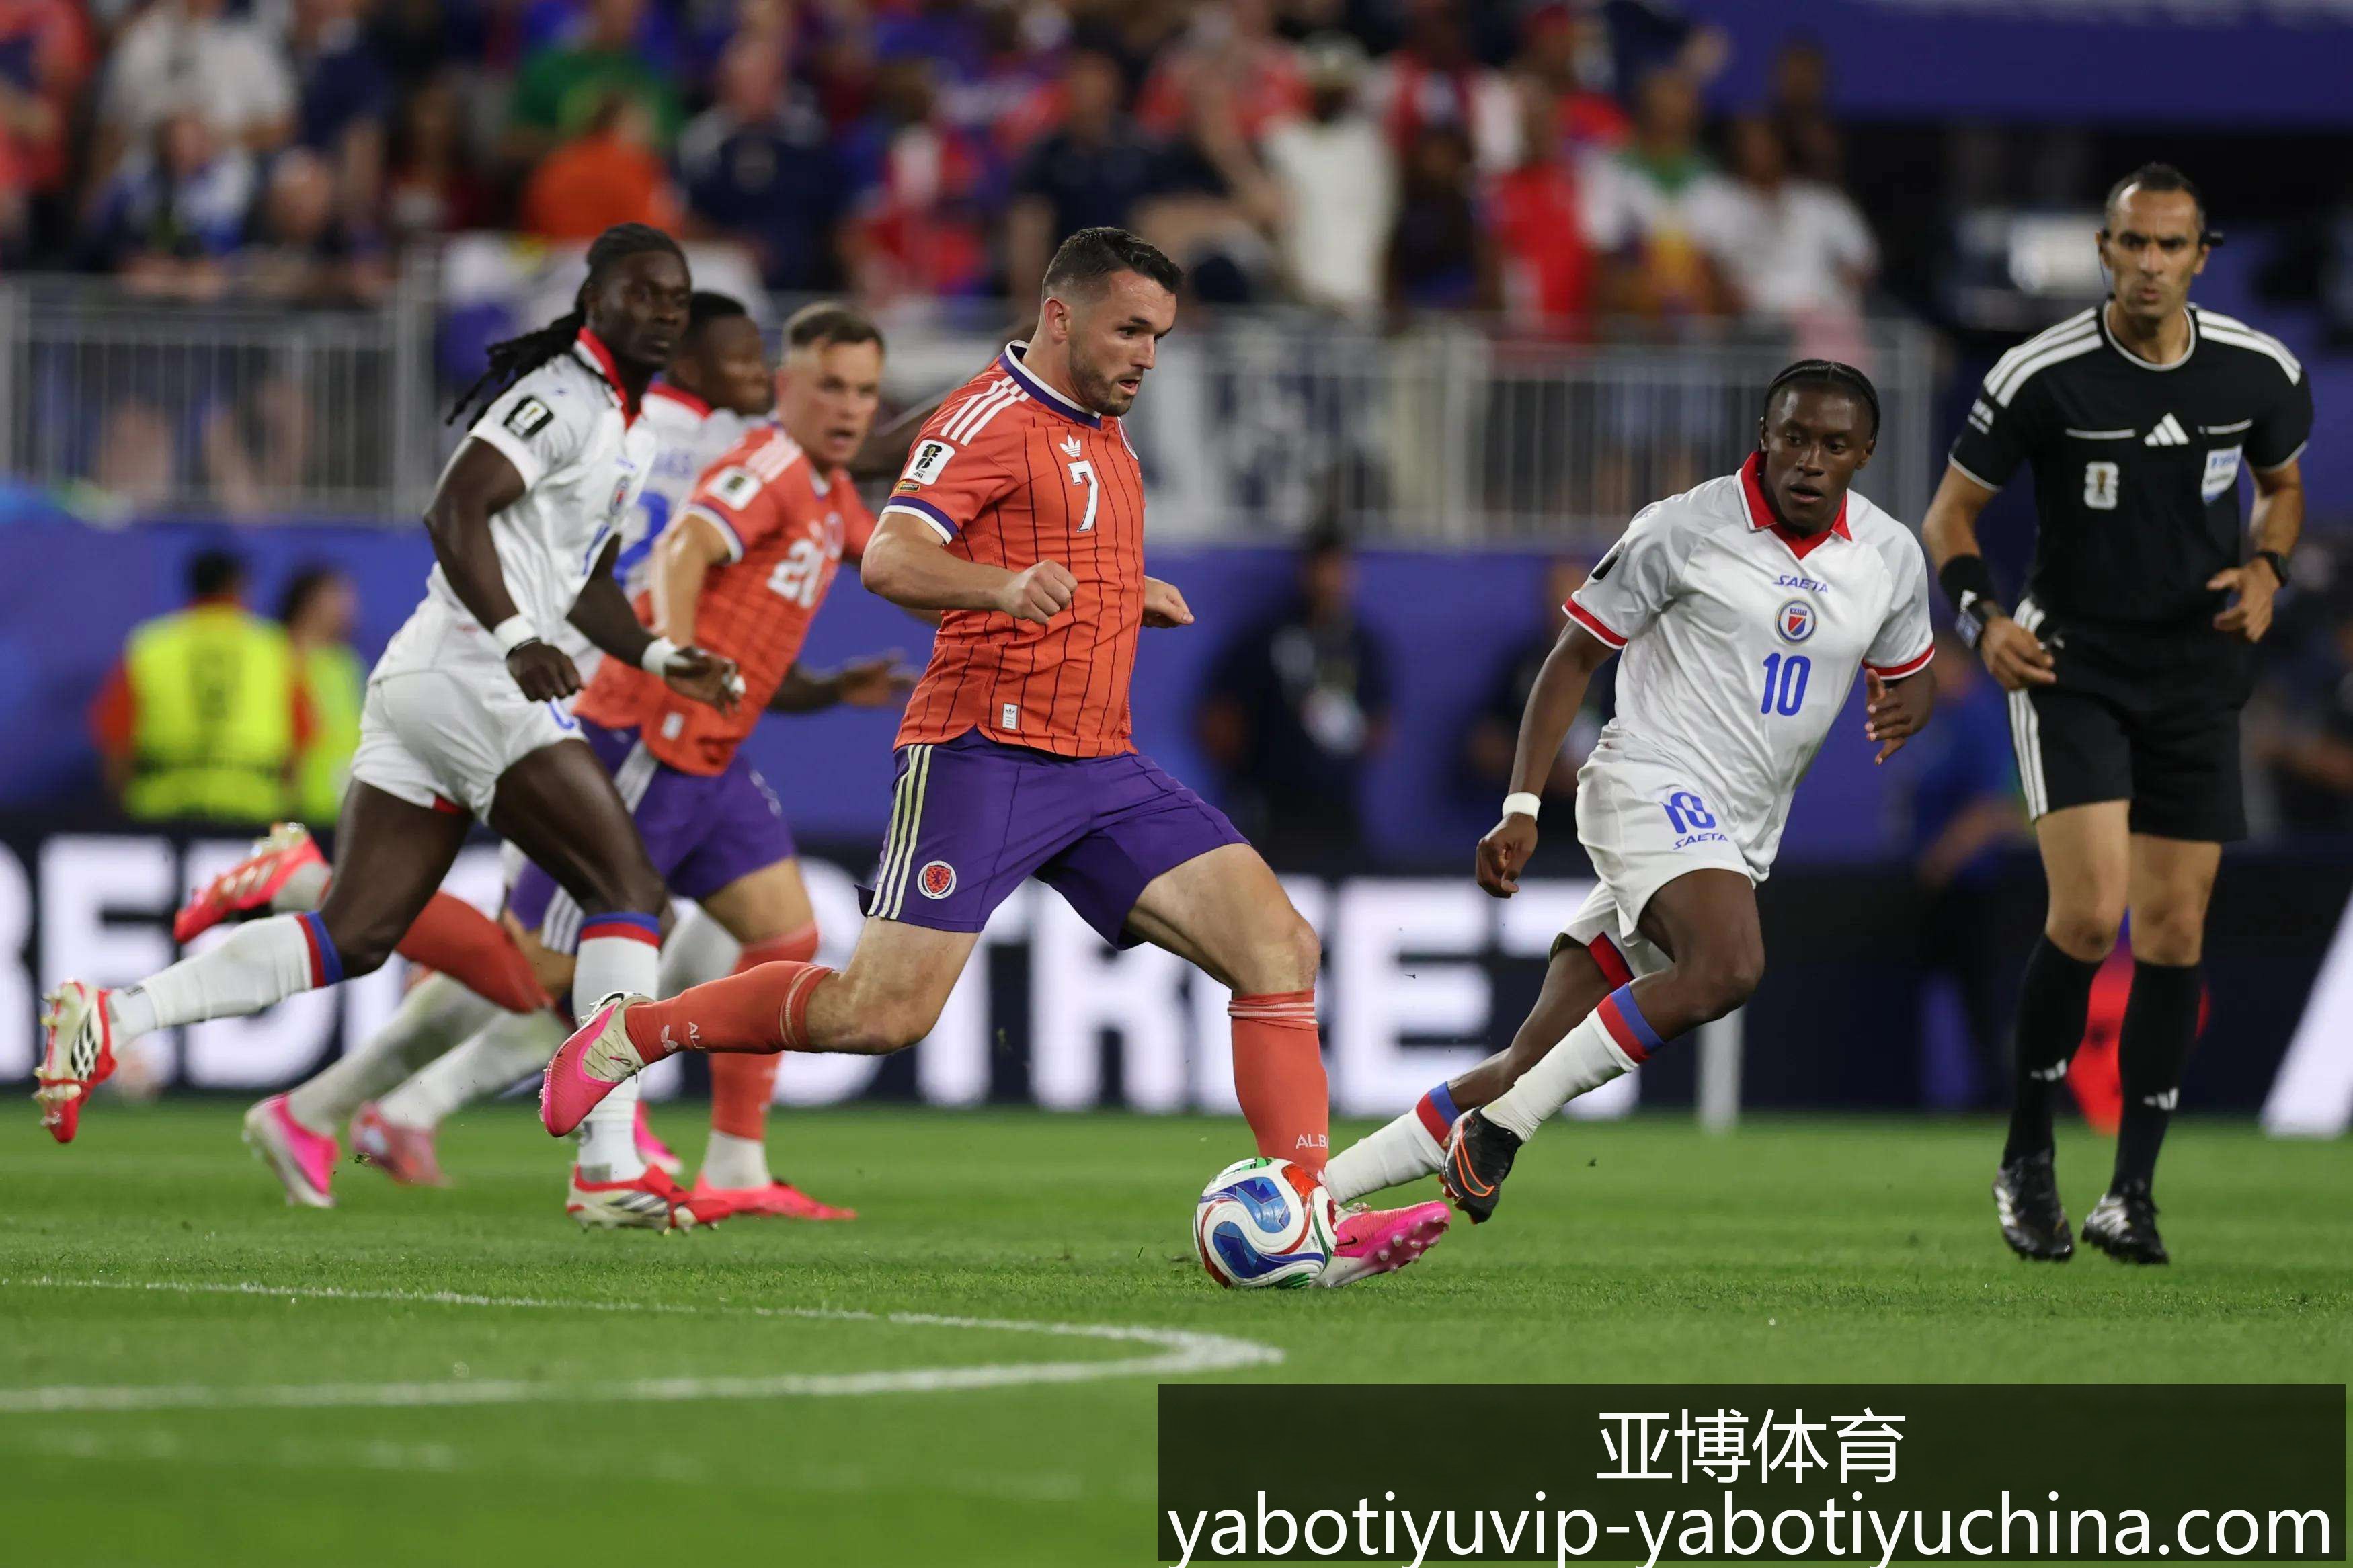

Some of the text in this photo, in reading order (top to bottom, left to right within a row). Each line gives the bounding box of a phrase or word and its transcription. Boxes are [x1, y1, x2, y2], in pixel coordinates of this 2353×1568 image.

[1067, 460, 1099, 532] 7
[1773, 575, 1828, 593] SAETA
[1761, 653, 1811, 716] 10
[1673, 833, 1729, 850] SAETA
[688, 1022, 706, 1049] AL
[1295, 1133, 1329, 1149] ALB
